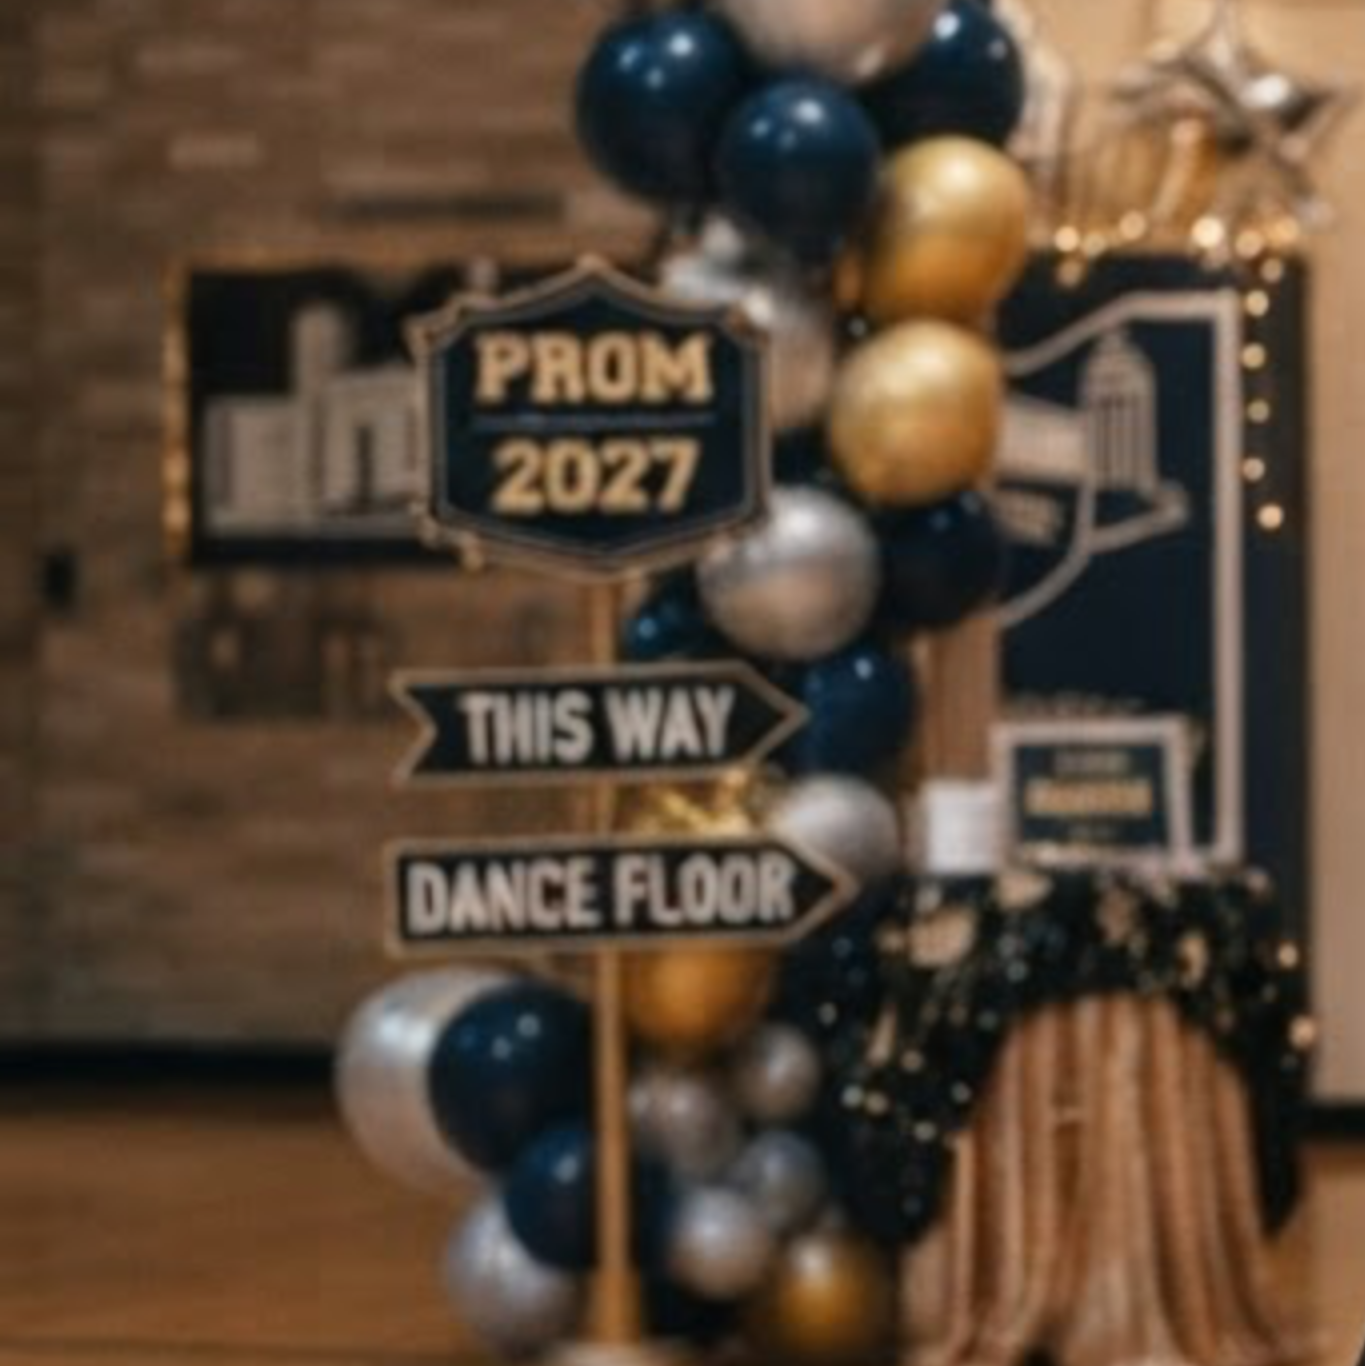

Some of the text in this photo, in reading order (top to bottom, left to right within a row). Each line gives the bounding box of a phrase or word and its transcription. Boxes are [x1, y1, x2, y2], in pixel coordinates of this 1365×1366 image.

[476, 332, 712, 403] PROM
[493, 441, 699, 513] 2027
[460, 686, 736, 765] THIS WAY
[406, 854, 796, 935] DANCE FLOOR
